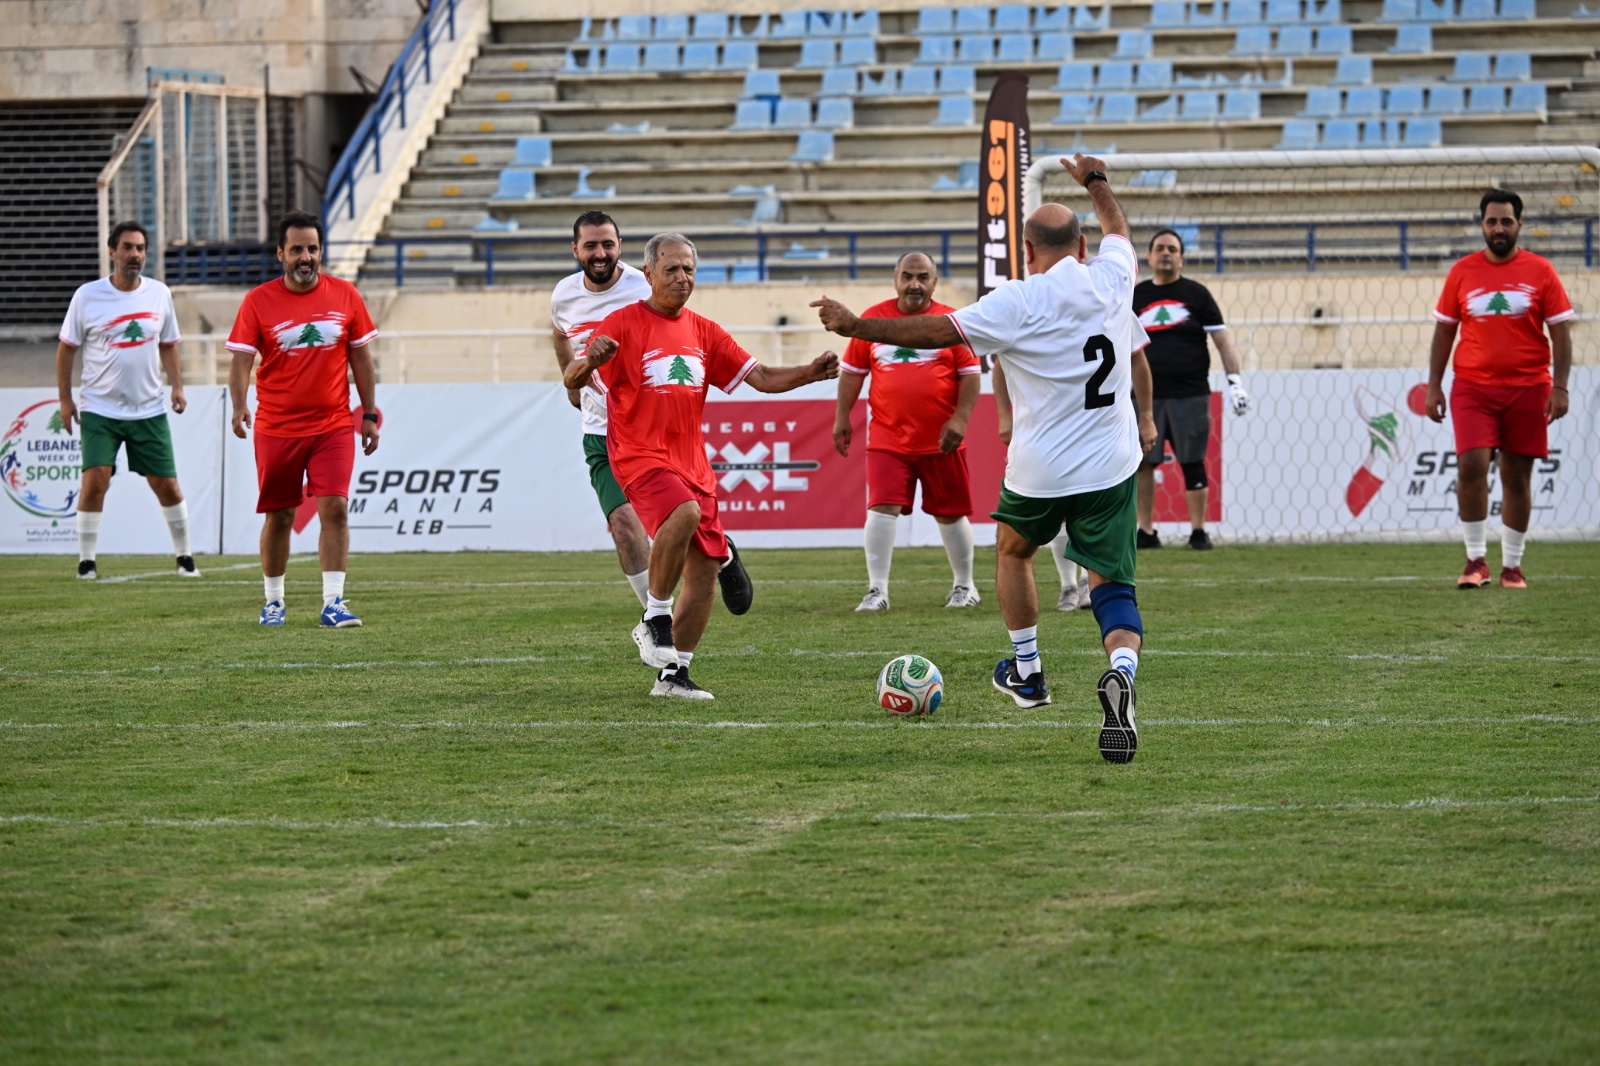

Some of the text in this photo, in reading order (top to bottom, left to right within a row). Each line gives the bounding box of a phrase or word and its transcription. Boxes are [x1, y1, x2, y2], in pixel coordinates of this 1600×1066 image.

[984, 120, 1007, 289] Fit961
[1083, 334, 1116, 410] 2
[701, 421, 797, 433] NERGY
[27, 440, 82, 451] LEBANE
[69, 453, 80, 461] OF
[1413, 449, 1561, 476] SPS
[26, 465, 82, 480] SPORT
[705, 441, 808, 493] XL
[355, 469, 501, 494] SPORTS
[349, 497, 493, 513] MANIA
[717, 500, 786, 512] GULAR
[396, 520, 444, 535] LEB
